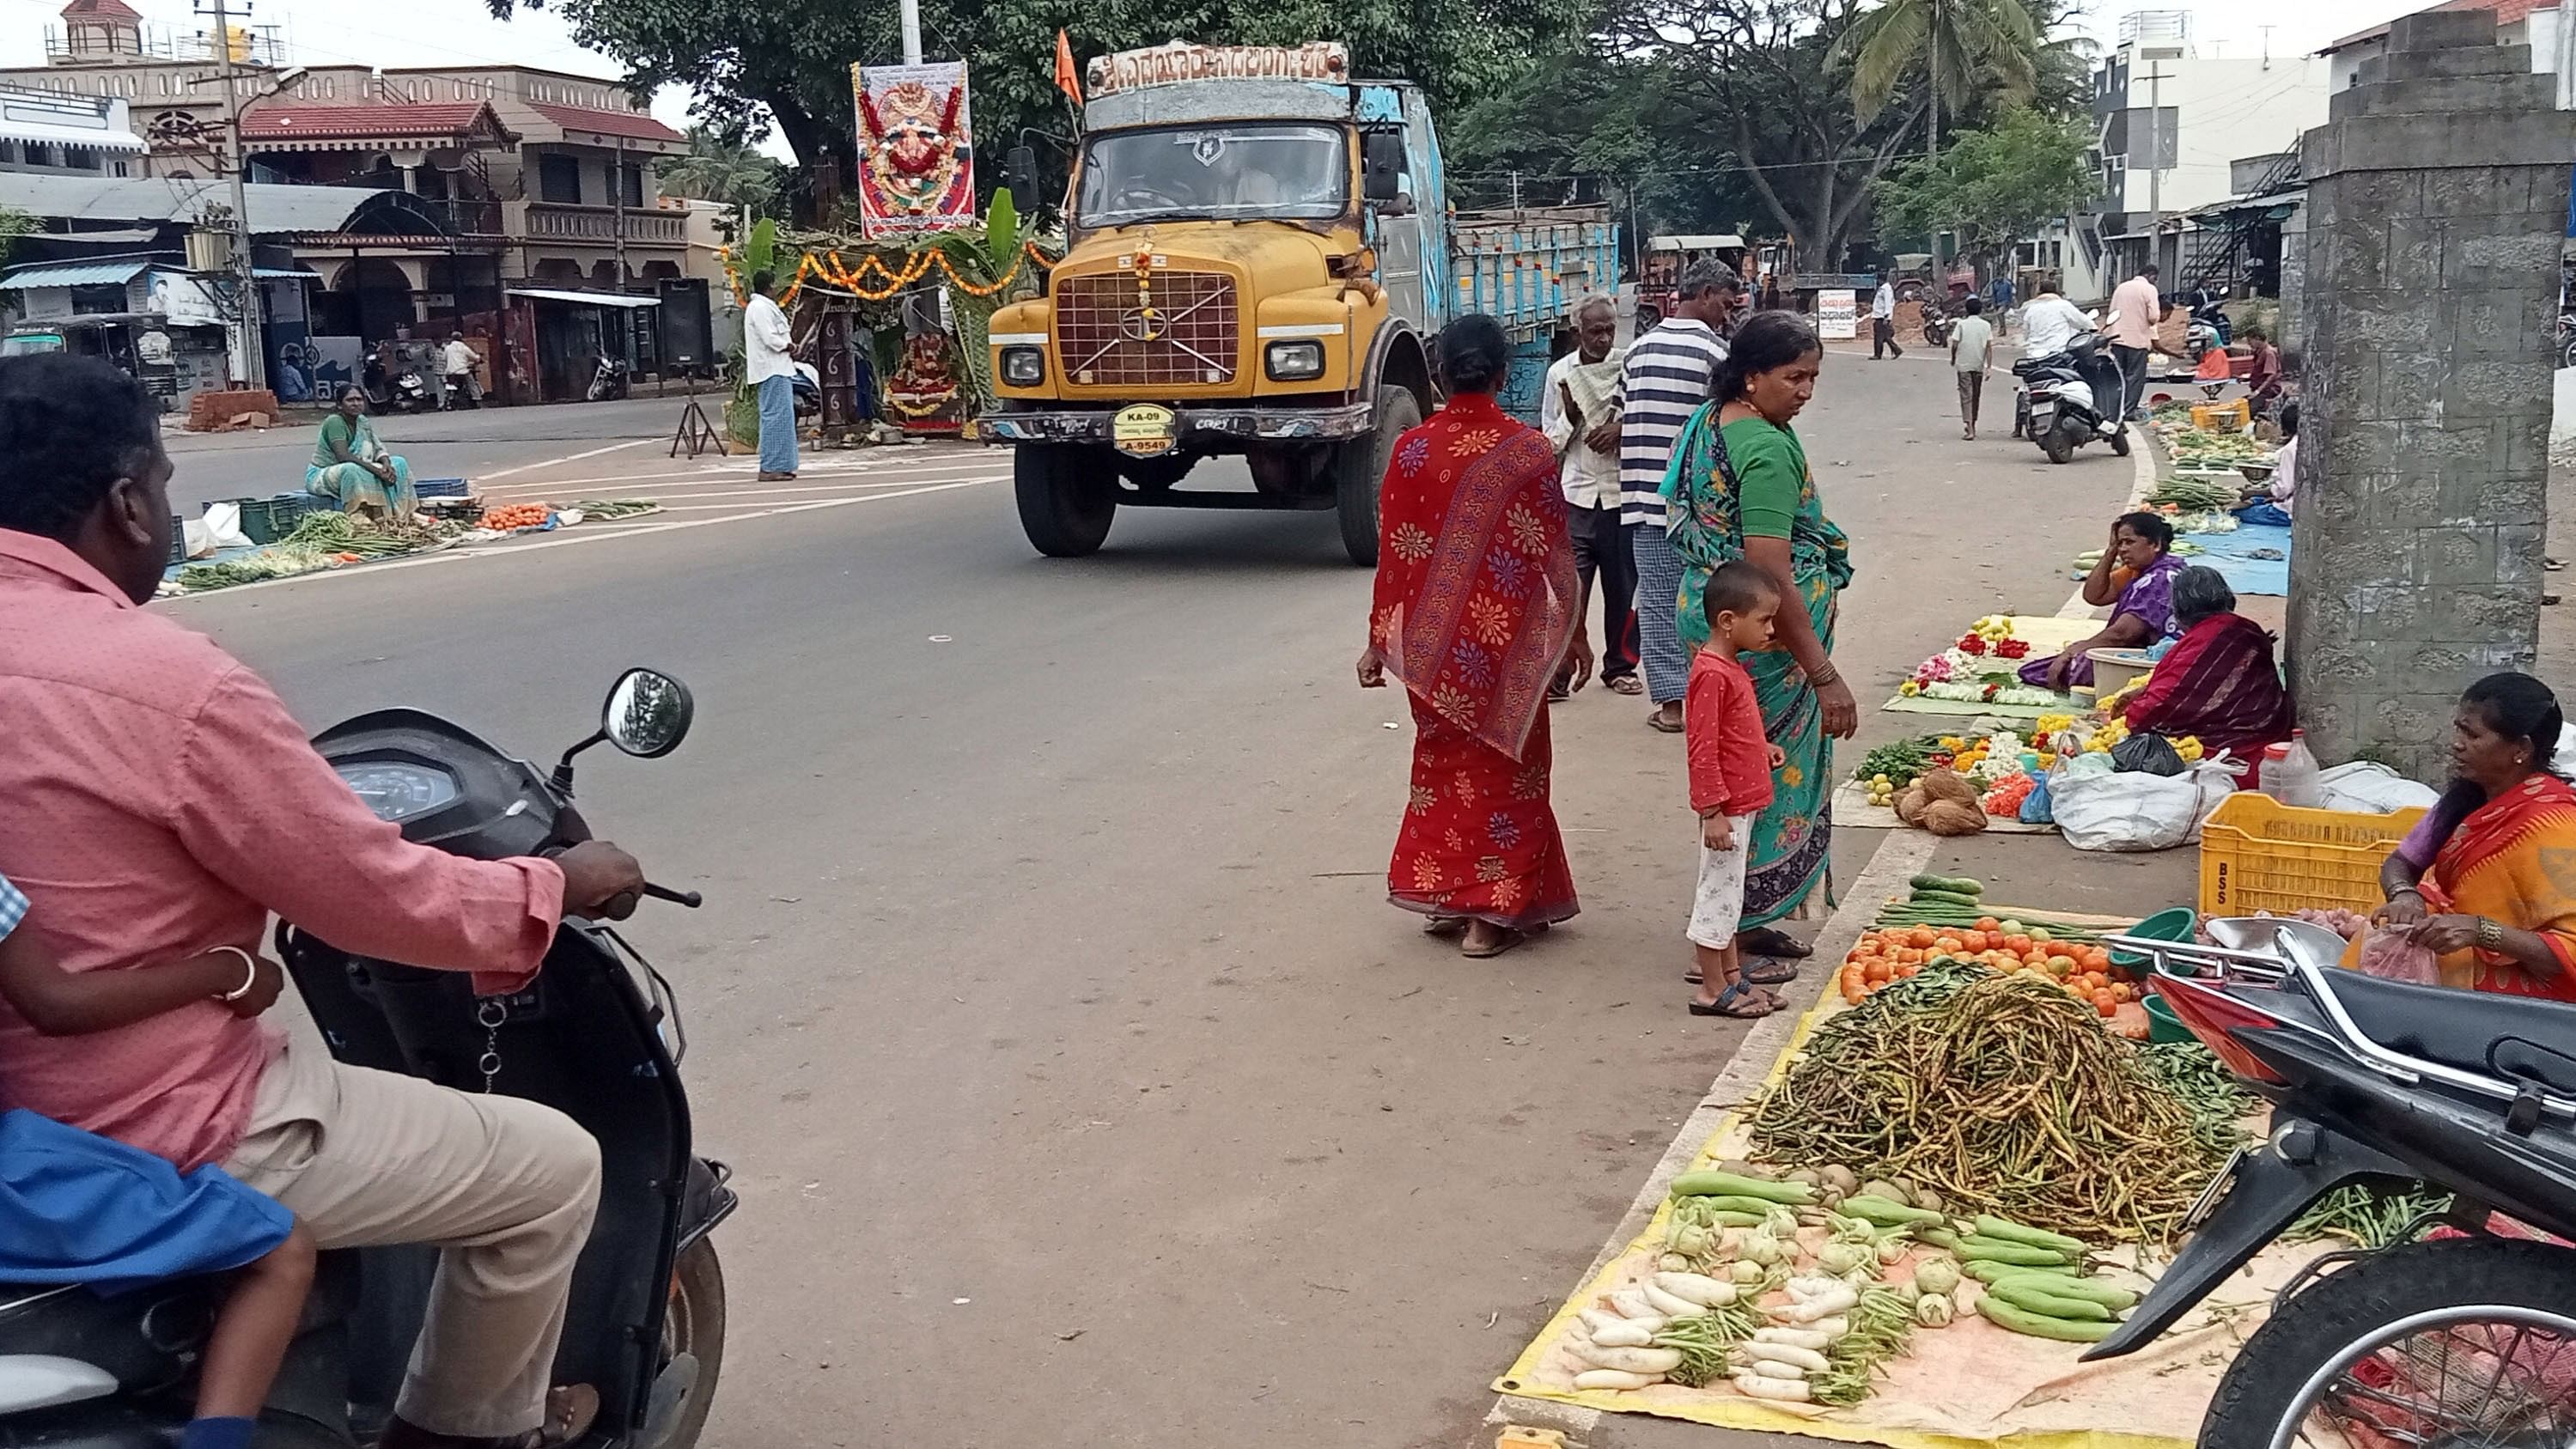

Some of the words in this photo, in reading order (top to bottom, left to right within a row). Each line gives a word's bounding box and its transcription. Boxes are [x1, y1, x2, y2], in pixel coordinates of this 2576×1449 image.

[1127, 412, 1160, 422] KA-09
[1125, 441, 1166, 450] A-9549
[2218, 862, 2227, 904] BSS
